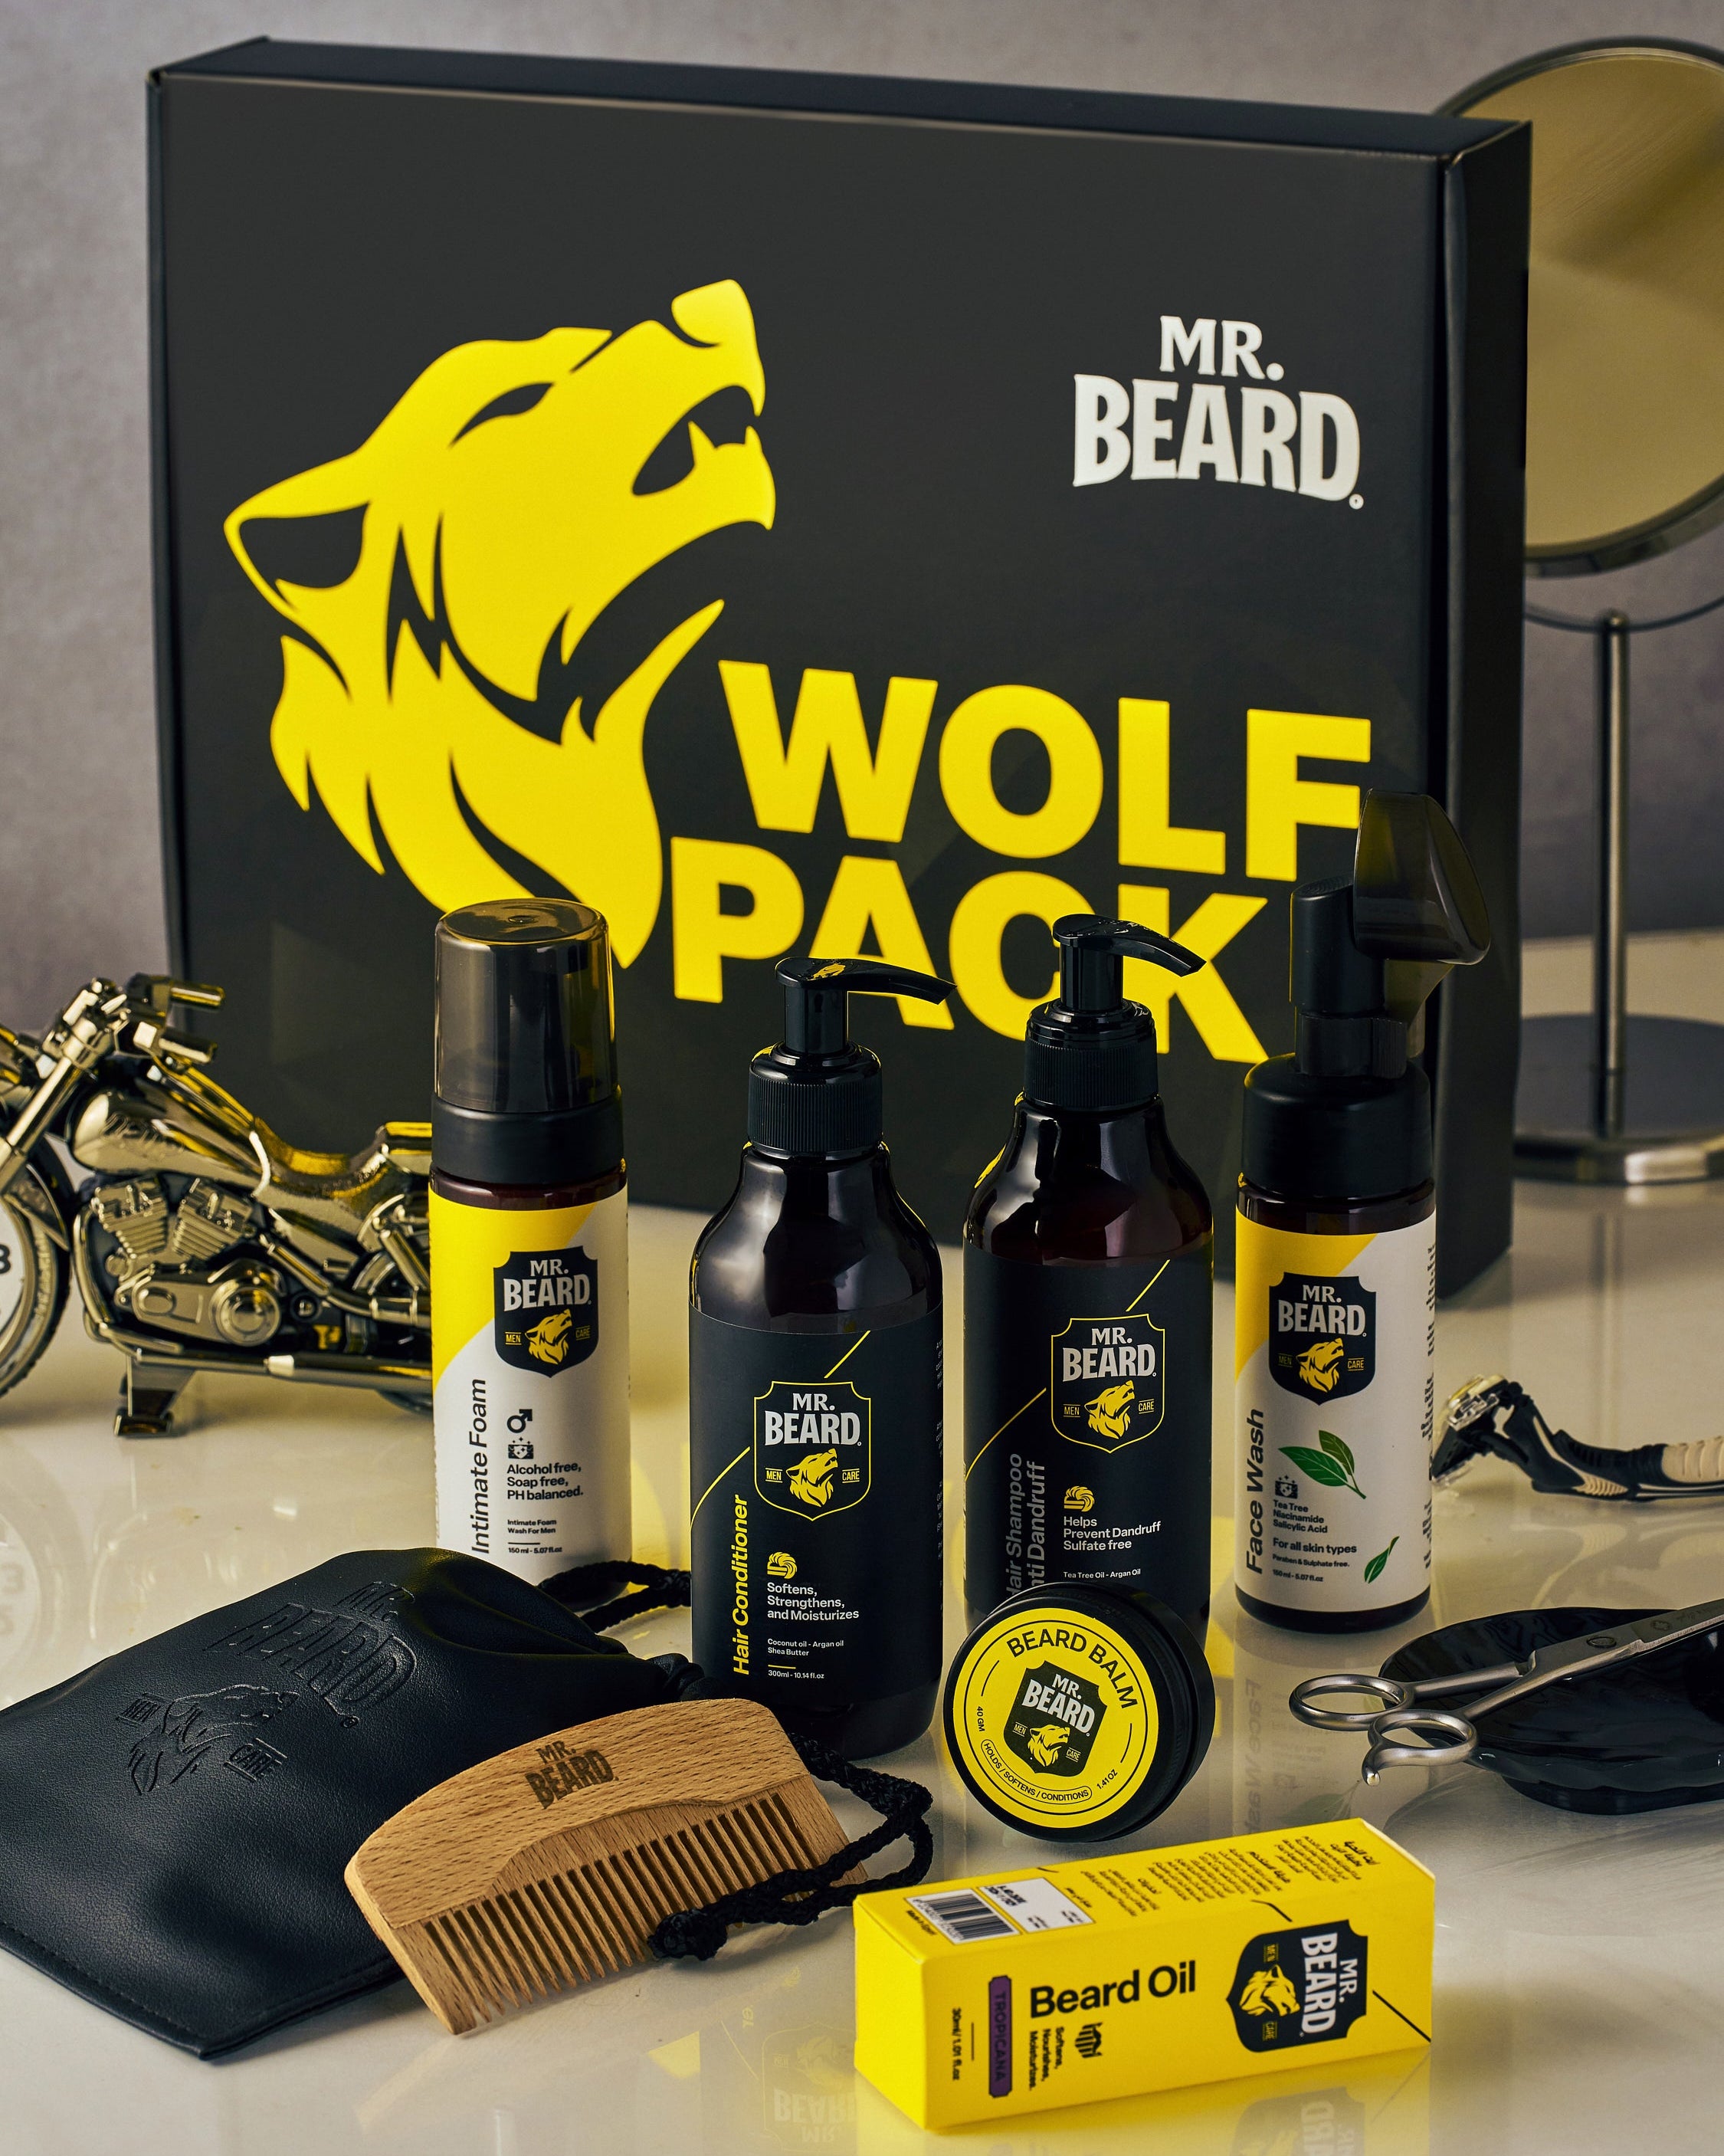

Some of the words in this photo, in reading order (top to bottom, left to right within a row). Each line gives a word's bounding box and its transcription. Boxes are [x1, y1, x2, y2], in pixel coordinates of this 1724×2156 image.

[1159, 315, 1285, 382] MR.
[718, 659, 1371, 881] WOLF
[670, 835, 1270, 1066] PACK
[529, 1259, 569, 1276] MR.
[1303, 1284, 1342, 1304] MR.
[506, 1334, 521, 1344] MEN
[575, 1327, 590, 1338] CARE
[1091, 1327, 1133, 1347] MR.
[1279, 1355, 1293, 1367] MEN
[1347, 1359, 1365, 1370] CARE
[792, 1393, 835, 1411] MR.
[1064, 1406, 1080, 1416] MEN
[1138, 1401, 1155, 1412] CARE
[469, 1379, 487, 1449] Foam
[1246, 1408, 1264, 1493] Wash
[507, 1463, 552, 1475] Alcohol
[553, 1462, 582, 1472] free,
[766, 1470, 782, 1480] MEN
[842, 1471, 860, 1482] CARE
[506, 1476, 538, 1489] Soap
[539, 1475, 569, 1487] free,
[507, 1489, 525, 1500] PH
[526, 1485, 584, 1500] balanced.
[470, 1452, 490, 1554] Intimate
[1005, 1453, 1026, 1558] Shampoo
[1026, 1460, 1045, 1561] Dandruff
[1273, 1499, 1288, 1510] Tea
[1289, 1502, 1309, 1513] Tree
[1064, 1516, 1098, 1529] Helps
[1273, 1509, 1325, 1524] Niacinamide
[1273, 1519, 1306, 1532] Salicylic
[1307, 1524, 1328, 1534] Acid
[1064, 1528, 1111, 1539] Prevent
[1112, 1520, 1162, 1538] Dandruff
[1246, 1499, 1264, 1575] Face
[1064, 1540, 1106, 1551] Sulfate
[1107, 1539, 1132, 1551] free
[1273, 1537, 1289, 1549] For
[1290, 1541, 1301, 1551] all
[1303, 1543, 1325, 1554] skin
[1326, 1544, 1357, 1556] types
[731, 1494, 749, 1626] Conditioner
[1273, 1553, 1297, 1565] Paraben
[1303, 1559, 1333, 1567] Sulphate
[1026, 1563, 1045, 1587] nti
[1109, 1570, 1131, 1579] Argan
[767, 1582, 818, 1596] Softens,
[767, 1595, 845, 1610] Strengthens,
[767, 1609, 789, 1620] and
[790, 1609, 860, 1621] Moisturizes
[732, 1629, 749, 1675] Hair
[767, 1638, 797, 1647] Coconut
[812, 1640, 834, 1649] Argan
[767, 1647, 785, 1656] Shea
[786, 1648, 810, 1656] Butter
[768, 1669, 789, 1678] 300ml
[1006, 1628, 1087, 1658] BEARD
[1088, 1643, 1138, 1709] BALM
[1051, 1673, 1082, 1700] MR.
[975, 1705, 984, 1717] 40
[976, 1718, 985, 1732] GM
[535, 1740, 577, 1764] MR.
[1013, 1724, 1027, 1735] MEN
[1066, 1749, 1081, 1762] CARE
[984, 1742, 1002, 1769] HOLDS
[1003, 1771, 1036, 1796] SOFTENS
[1041, 1789, 1089, 1801] CONDITIONS
[1096, 1777, 1109, 1790] 1.41
[1107, 1768, 1118, 1781] OZ
[1031, 1969, 1140, 2019] Beard
[1148, 1960, 1196, 1998] Oil
[1339, 1958, 1358, 2003] MR.
[993, 1992, 1006, 2082] TROPICANA
[952, 2038, 962, 2058] 1.01
[1041, 2029, 1052, 2082] Nourishes,
[1054, 2026, 1065, 2069] Softens,
[1028, 2030, 1039, 2092] Moisturizes.
